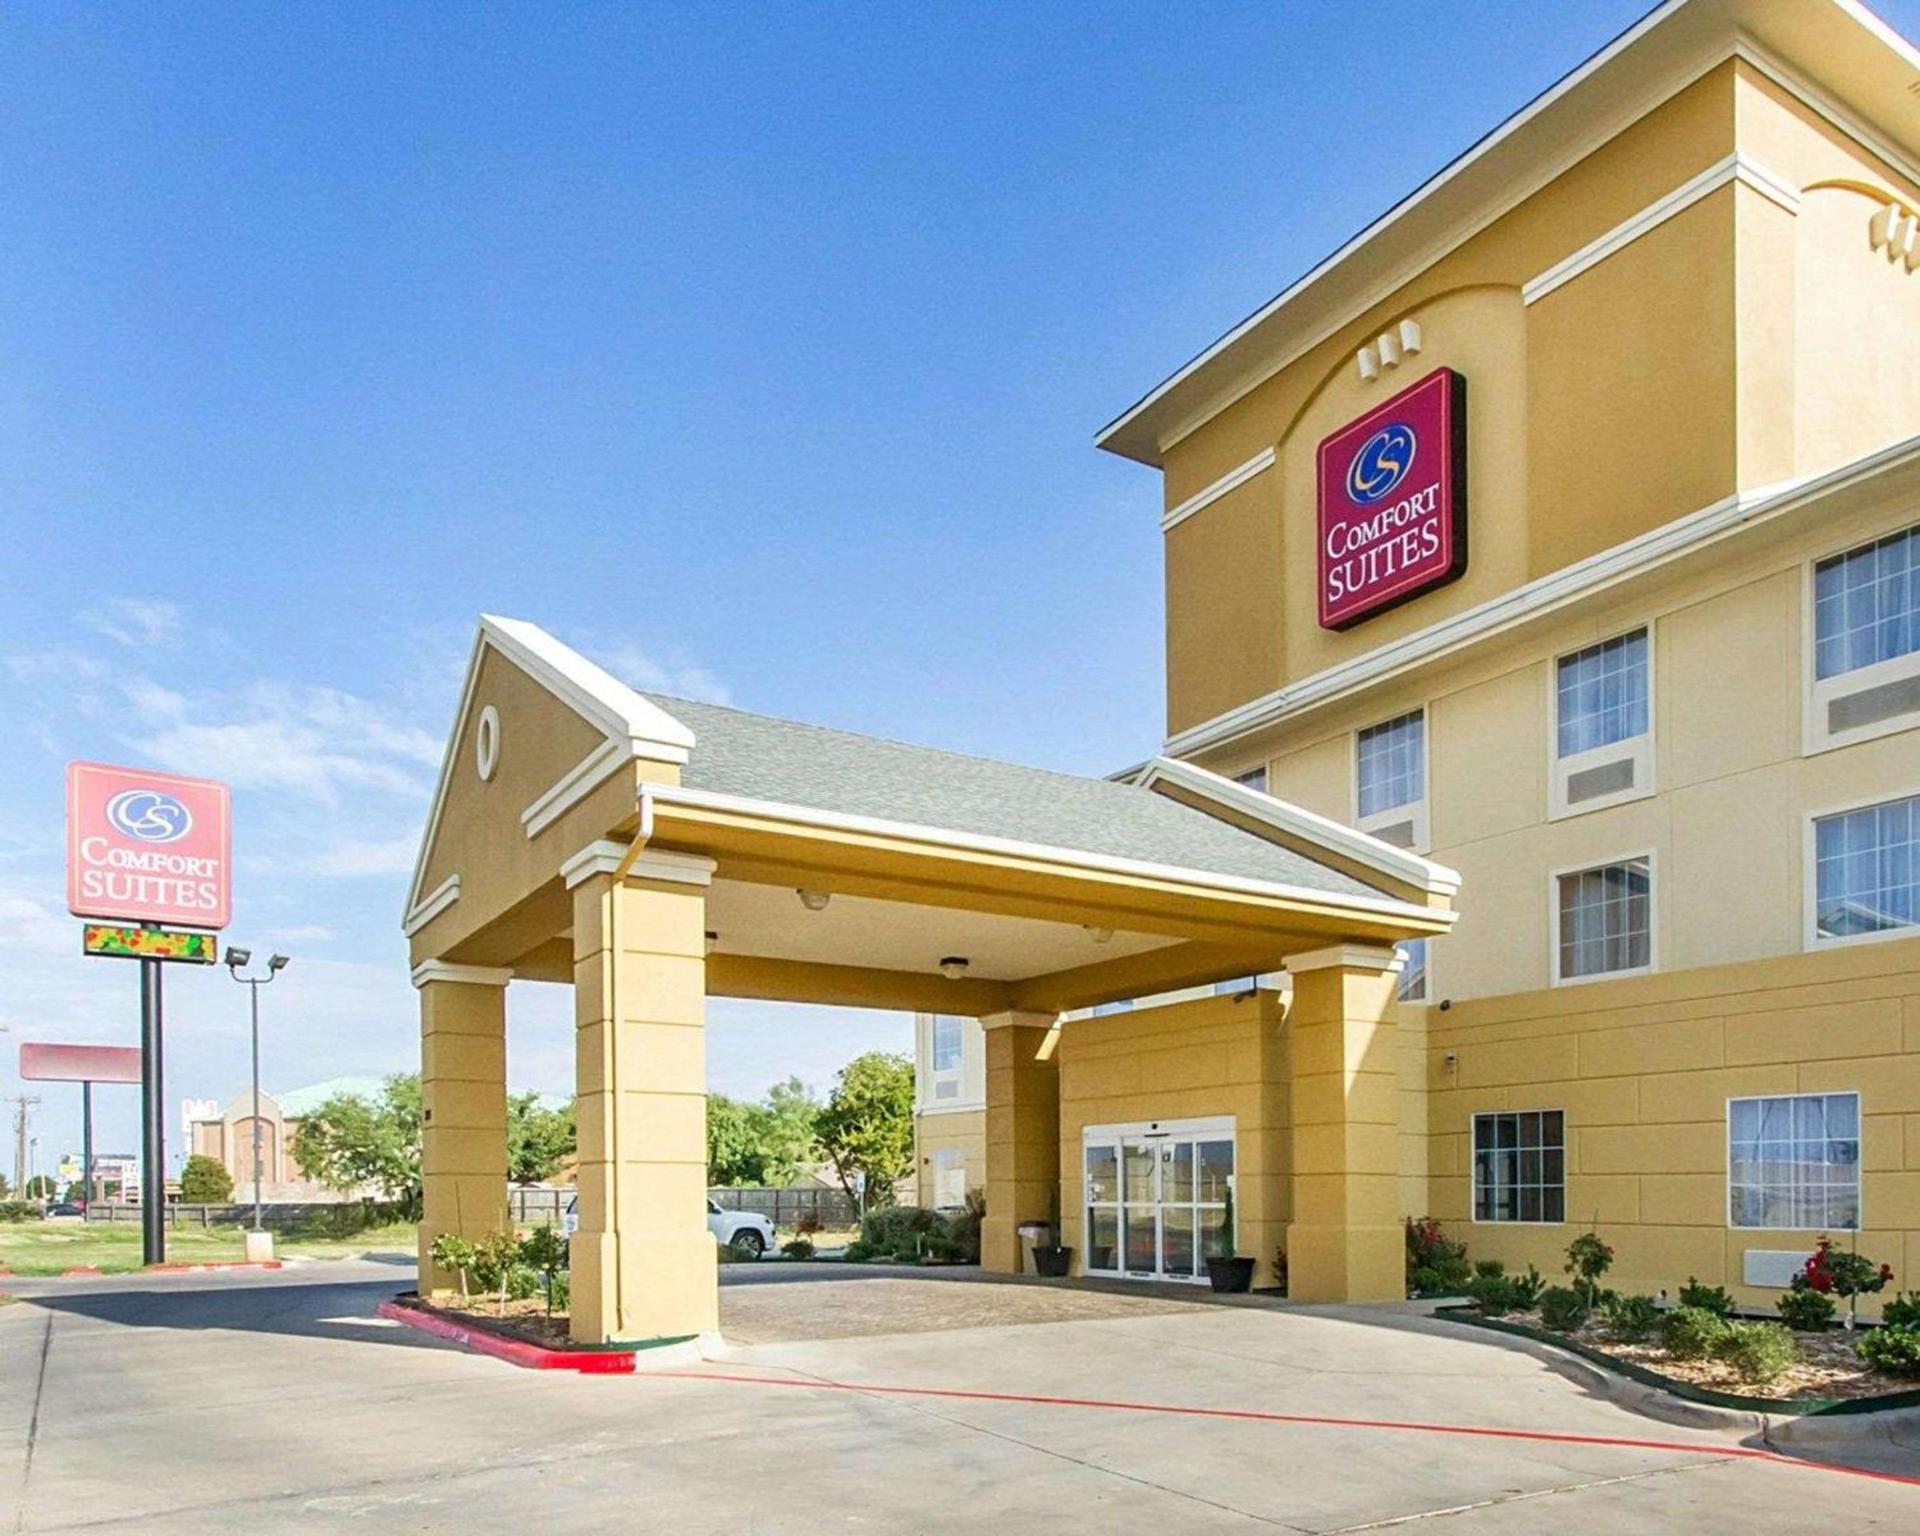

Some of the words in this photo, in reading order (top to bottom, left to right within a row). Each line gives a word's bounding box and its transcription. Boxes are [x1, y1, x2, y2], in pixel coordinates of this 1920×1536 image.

[1327, 483, 1440, 559] COMFORT
[1328, 517, 1440, 602] SUITES
[80, 836, 219, 878] COMFORT
[82, 869, 218, 910] SUITES
